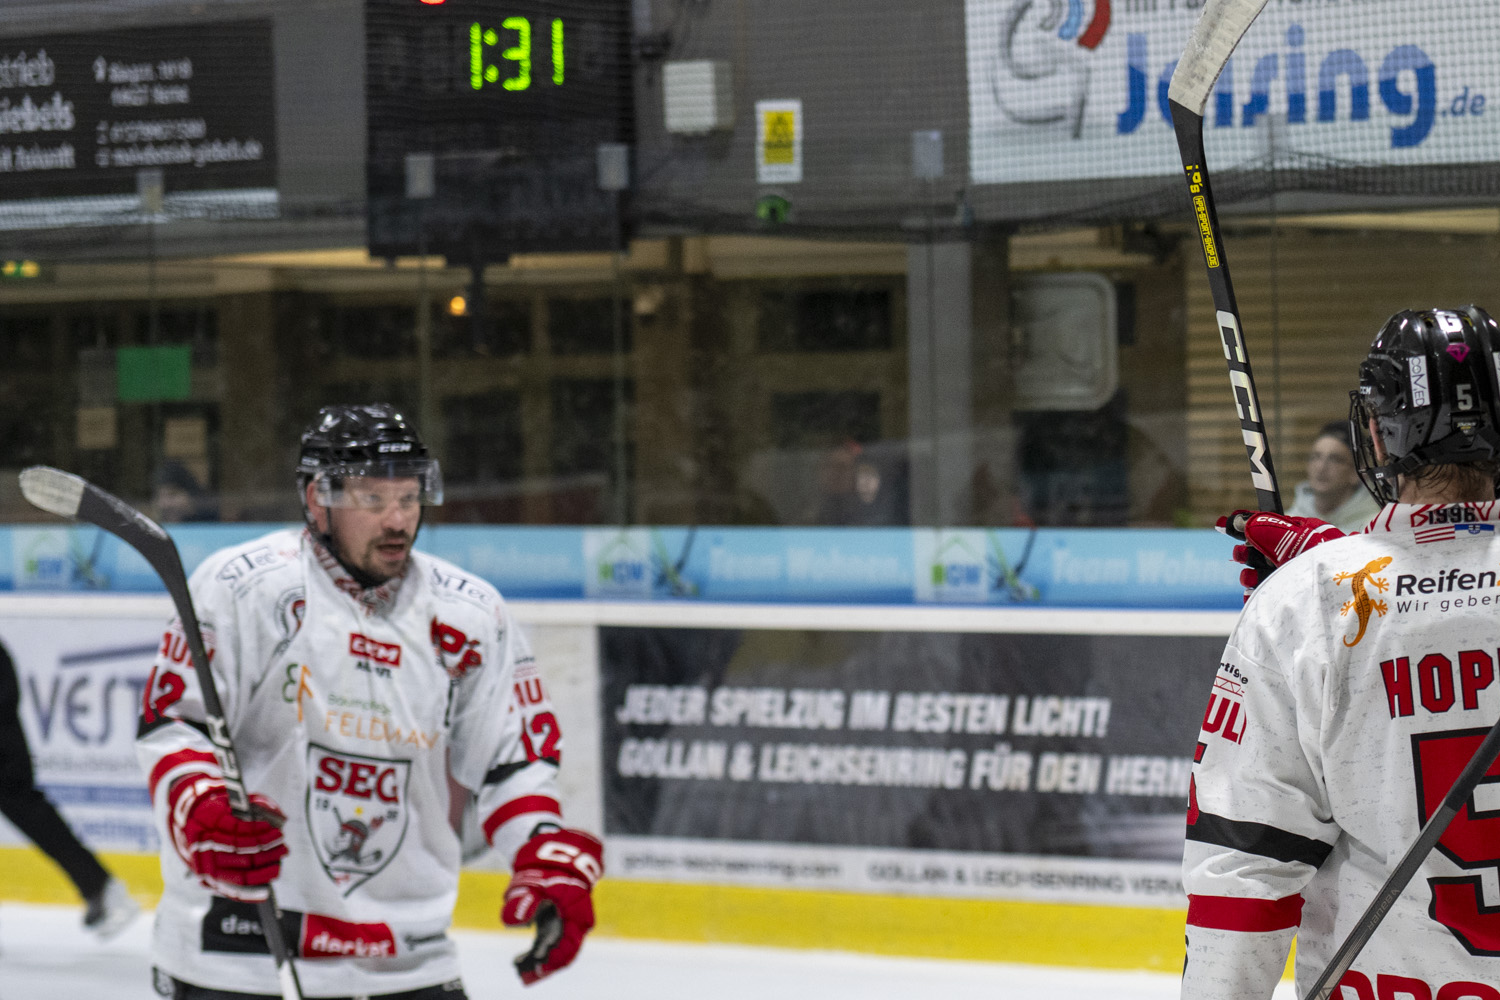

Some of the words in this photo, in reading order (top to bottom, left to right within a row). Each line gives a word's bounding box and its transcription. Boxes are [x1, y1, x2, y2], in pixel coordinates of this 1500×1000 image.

[470, 15, 564, 91] 1:31
[1216, 310, 1277, 493] CCM
[1456, 383, 1473, 411] 5
[1256, 515, 1294, 528] CCM
[1428, 507, 1477, 525] 1996
[1397, 599, 1429, 613] Wir
[617, 685, 706, 725] JEDER
[710, 686, 845, 730] SPIELZUG
[849, 692, 889, 729] IM
[892, 694, 1010, 733] BESTEN
[1013, 697, 1111, 737] LICHT!
[315, 755, 400, 804] SEG
[618, 739, 723, 778] GOLLAN
[729, 746, 755, 778] &
[759, 745, 967, 789] LEICHSENRING
[970, 745, 1031, 793] FÜR
[1037, 753, 1099, 793] DEN
